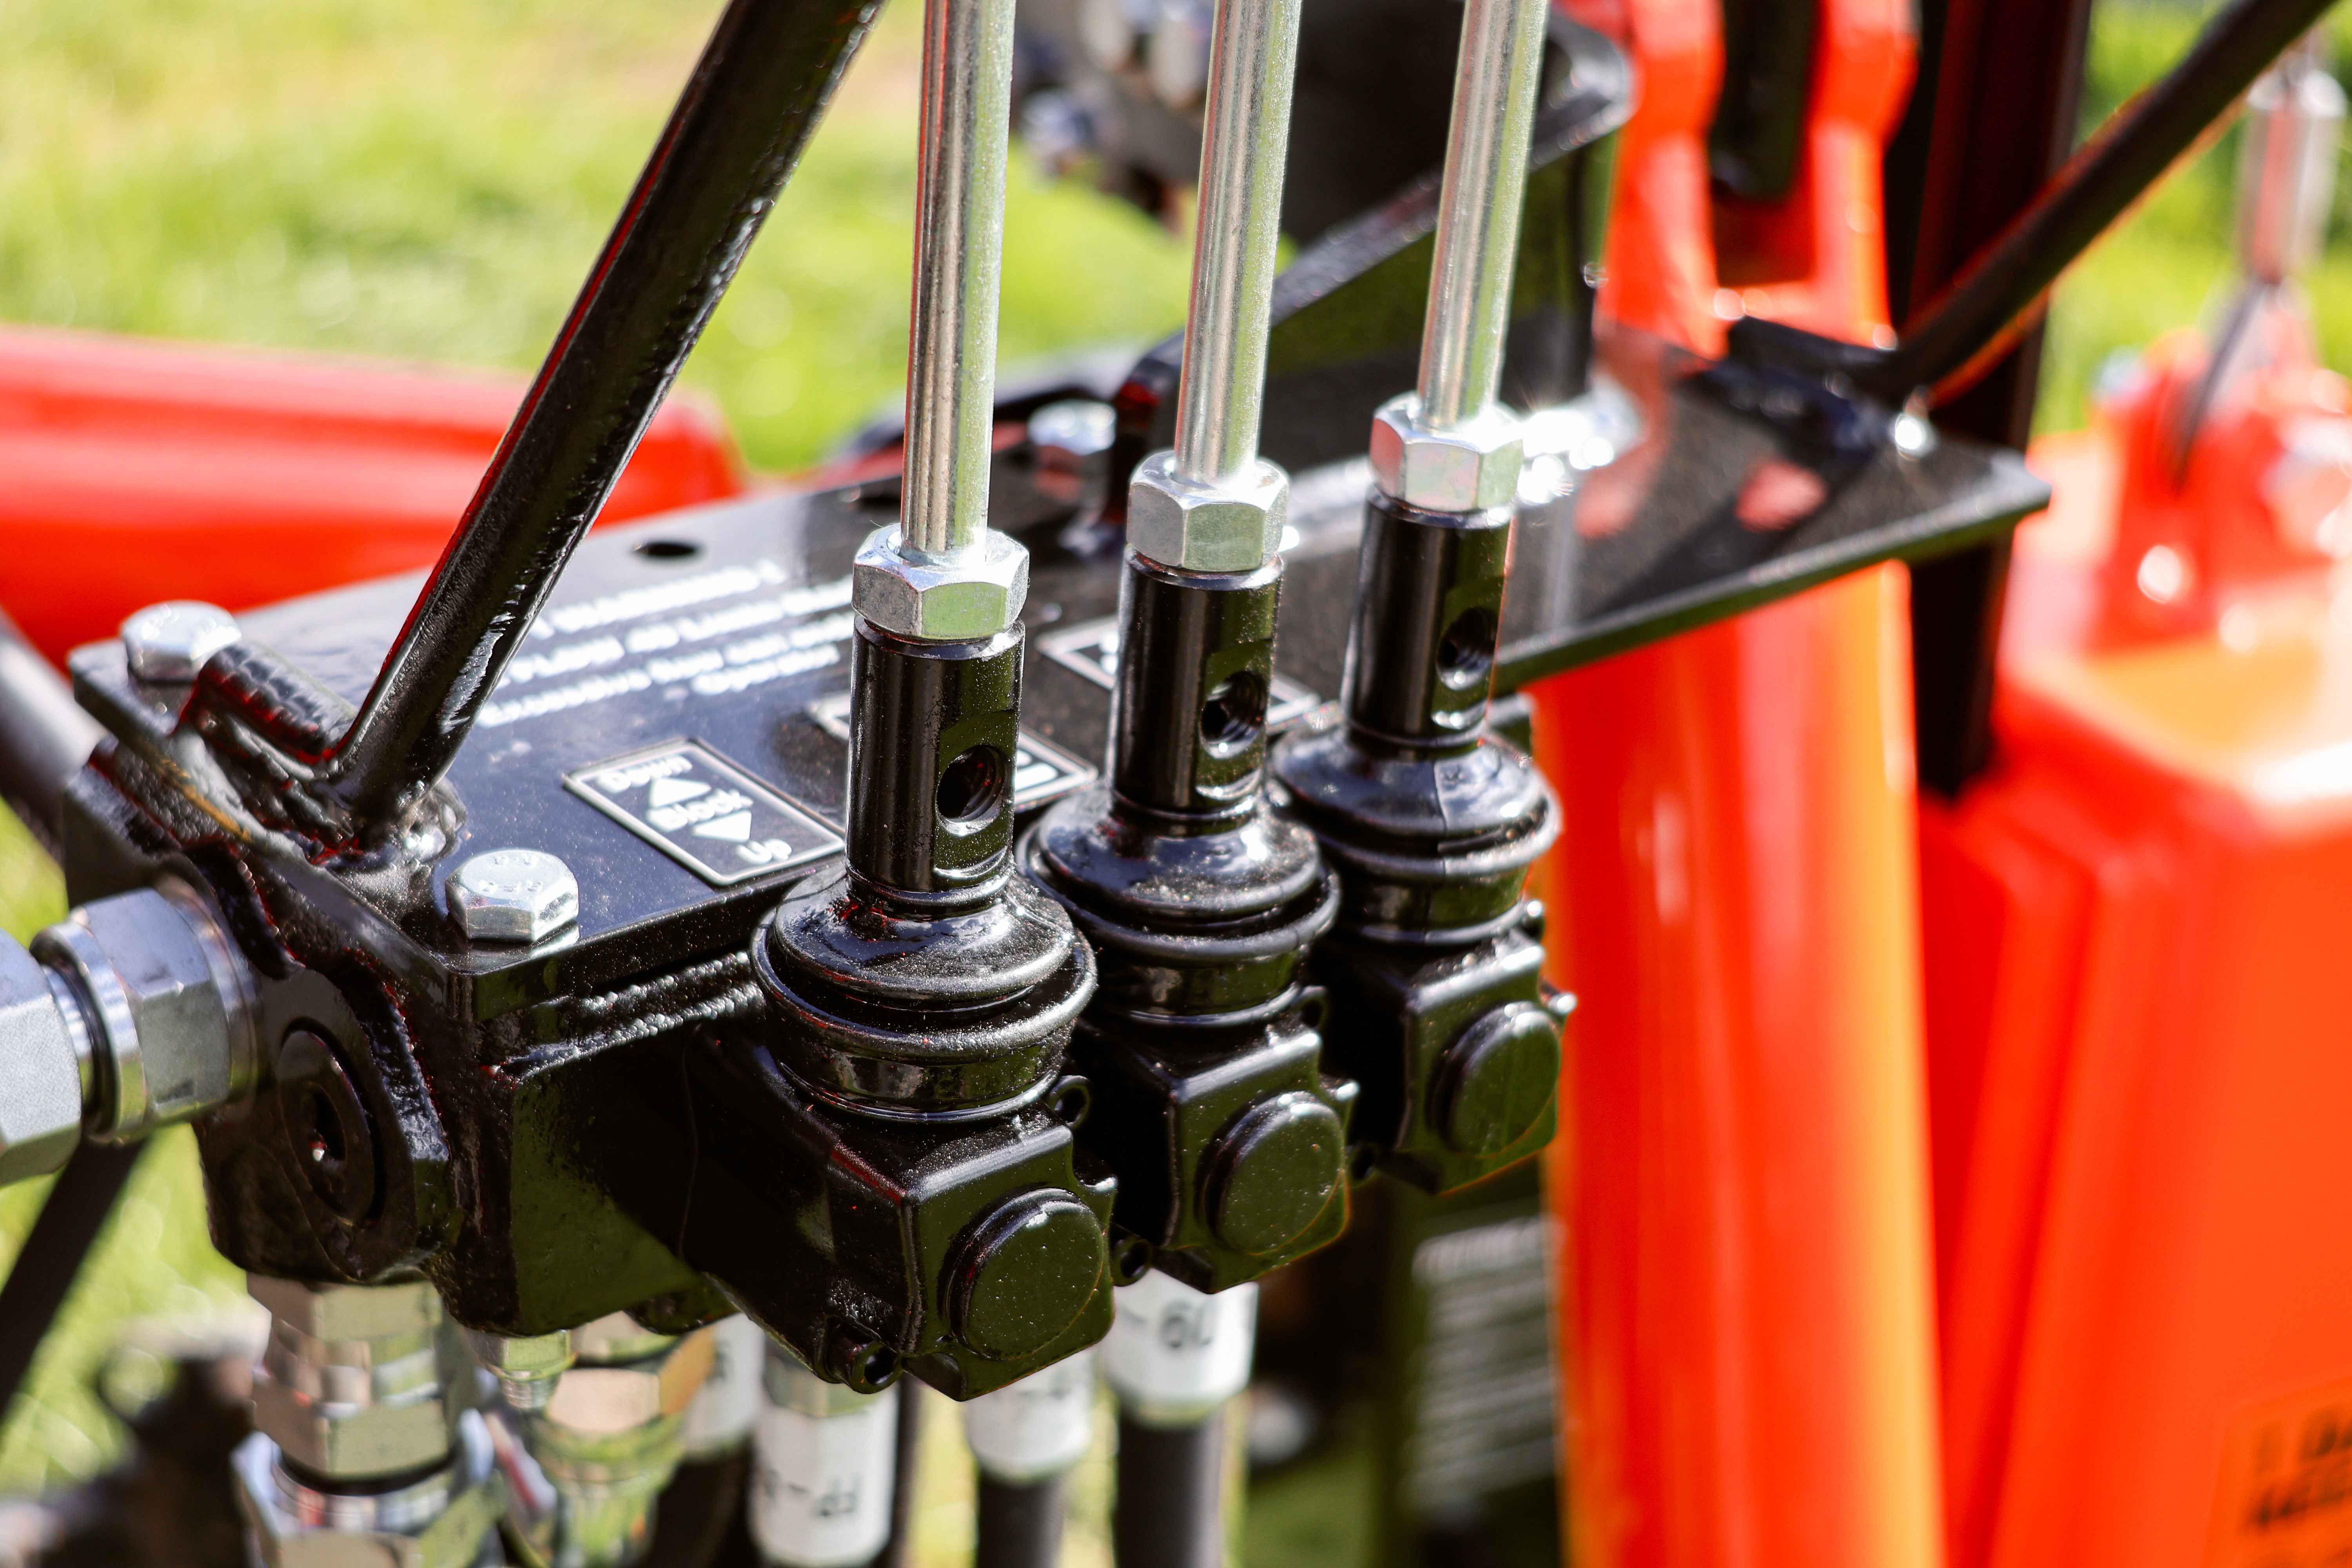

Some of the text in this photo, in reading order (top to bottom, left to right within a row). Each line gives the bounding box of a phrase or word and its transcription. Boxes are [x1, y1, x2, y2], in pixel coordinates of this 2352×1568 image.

[597, 754, 692, 793] Down
[646, 788, 753, 831] Block
[736, 838, 791, 864] Up
